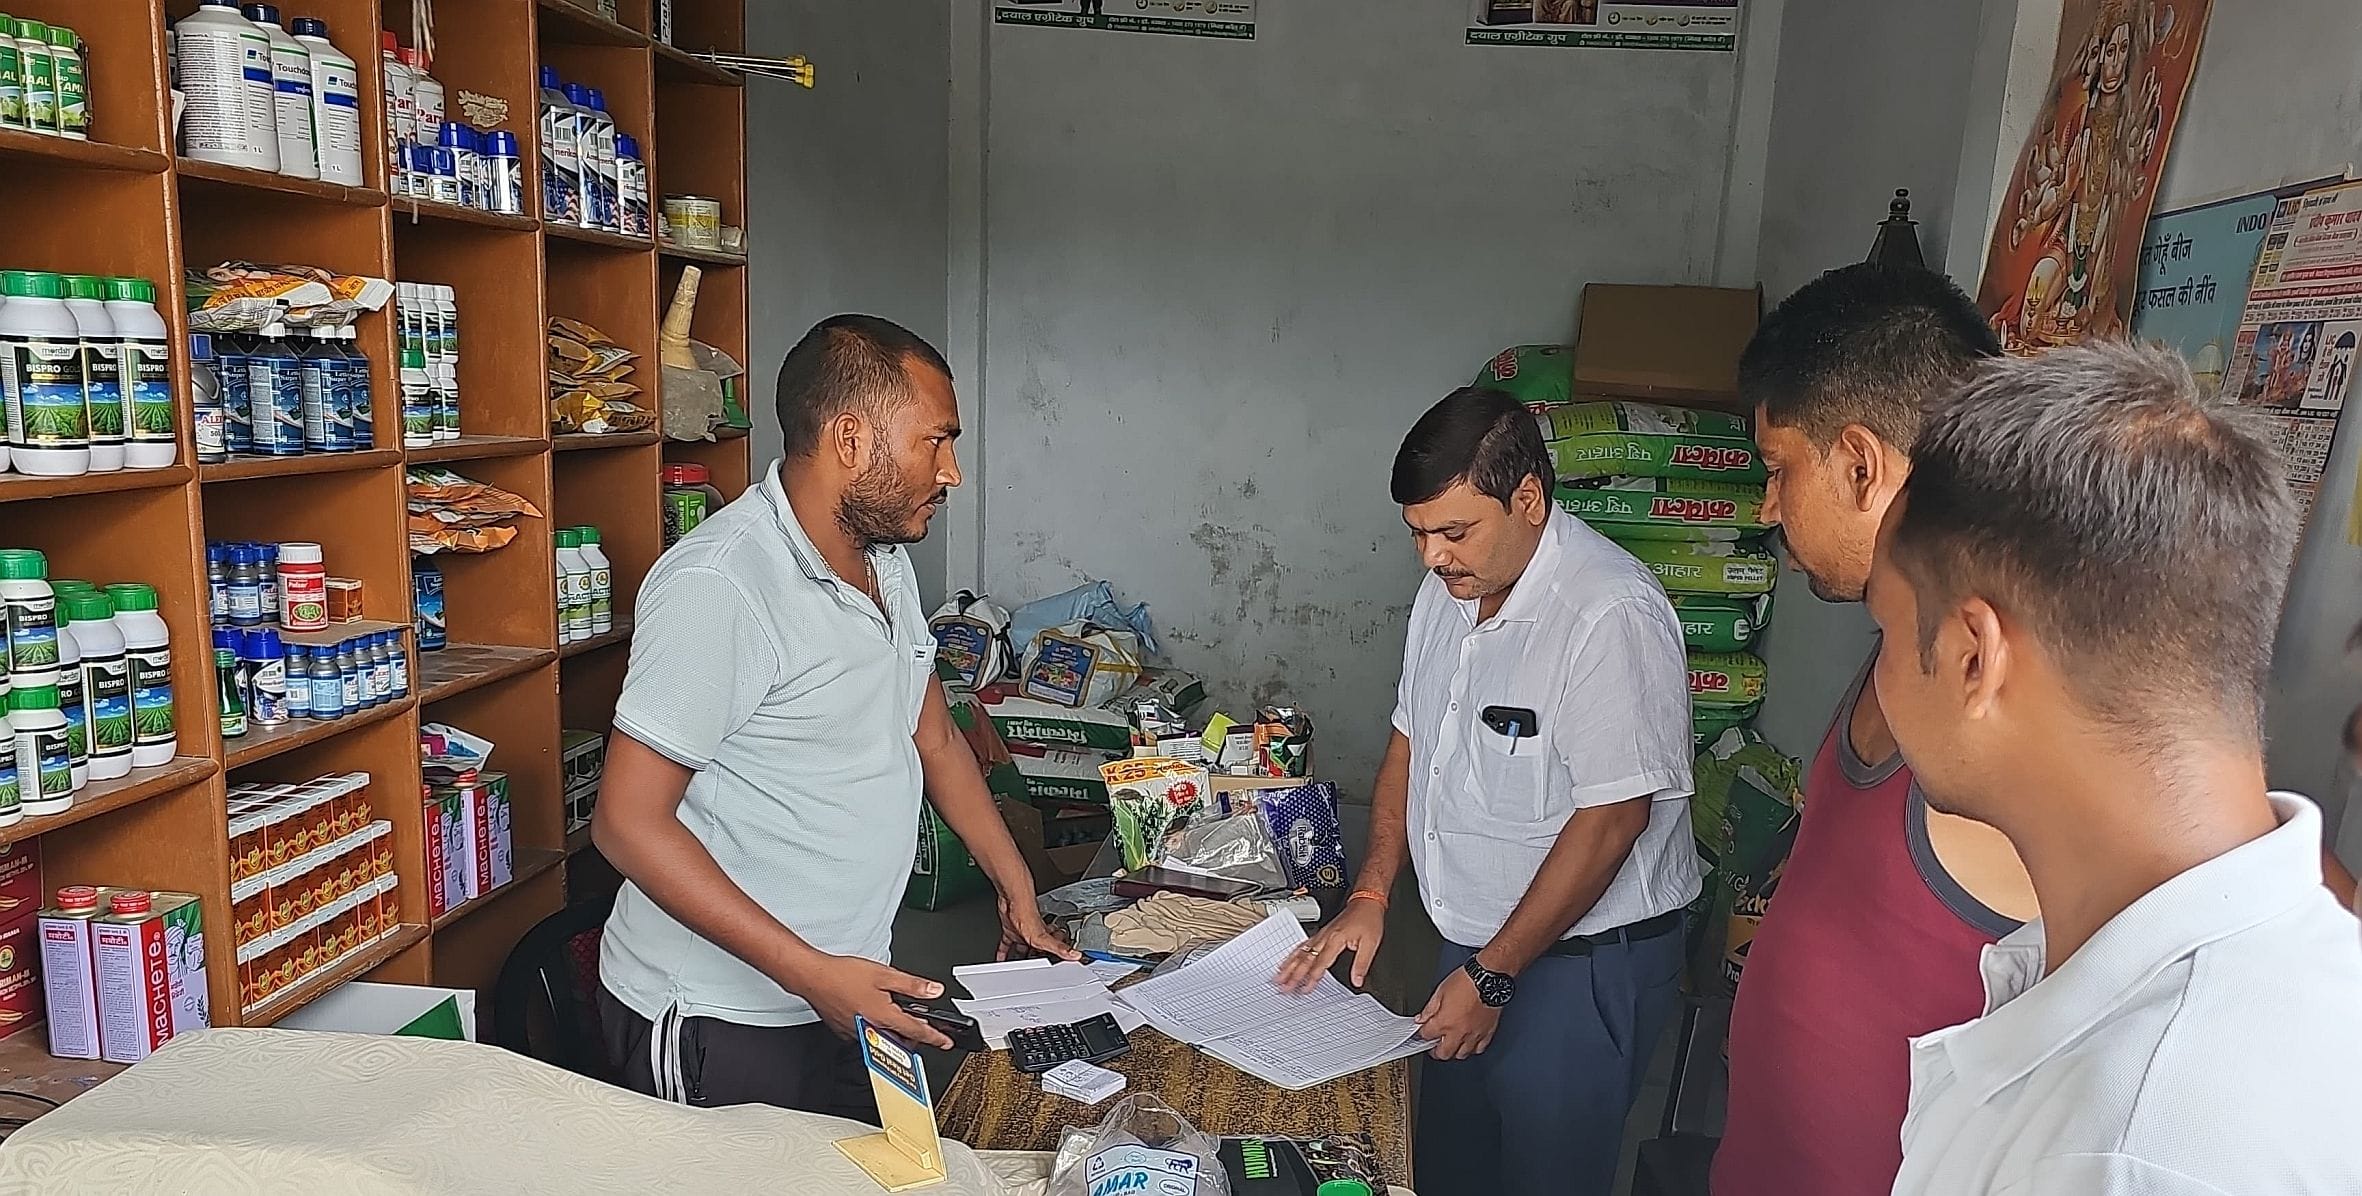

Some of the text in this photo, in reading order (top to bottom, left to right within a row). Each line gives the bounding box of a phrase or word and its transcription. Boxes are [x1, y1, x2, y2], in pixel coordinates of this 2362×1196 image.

[276, 63, 312, 76] Touchdo
[2236, 213, 2267, 234] INDO
[2149, 286, 2176, 309] फसल
[2178, 277, 2194, 305] की
[26, 364, 61, 373] BISPRO
[138, 364, 165, 372] BISPRO
[1652, 563, 1703, 578] आहार
[19, 614, 48, 622] BISPRO
[140, 669, 166, 680] BISPRO
[99, 678, 124, 689] BISPRO
[1093, 1172, 1149, 1196] AMAR
